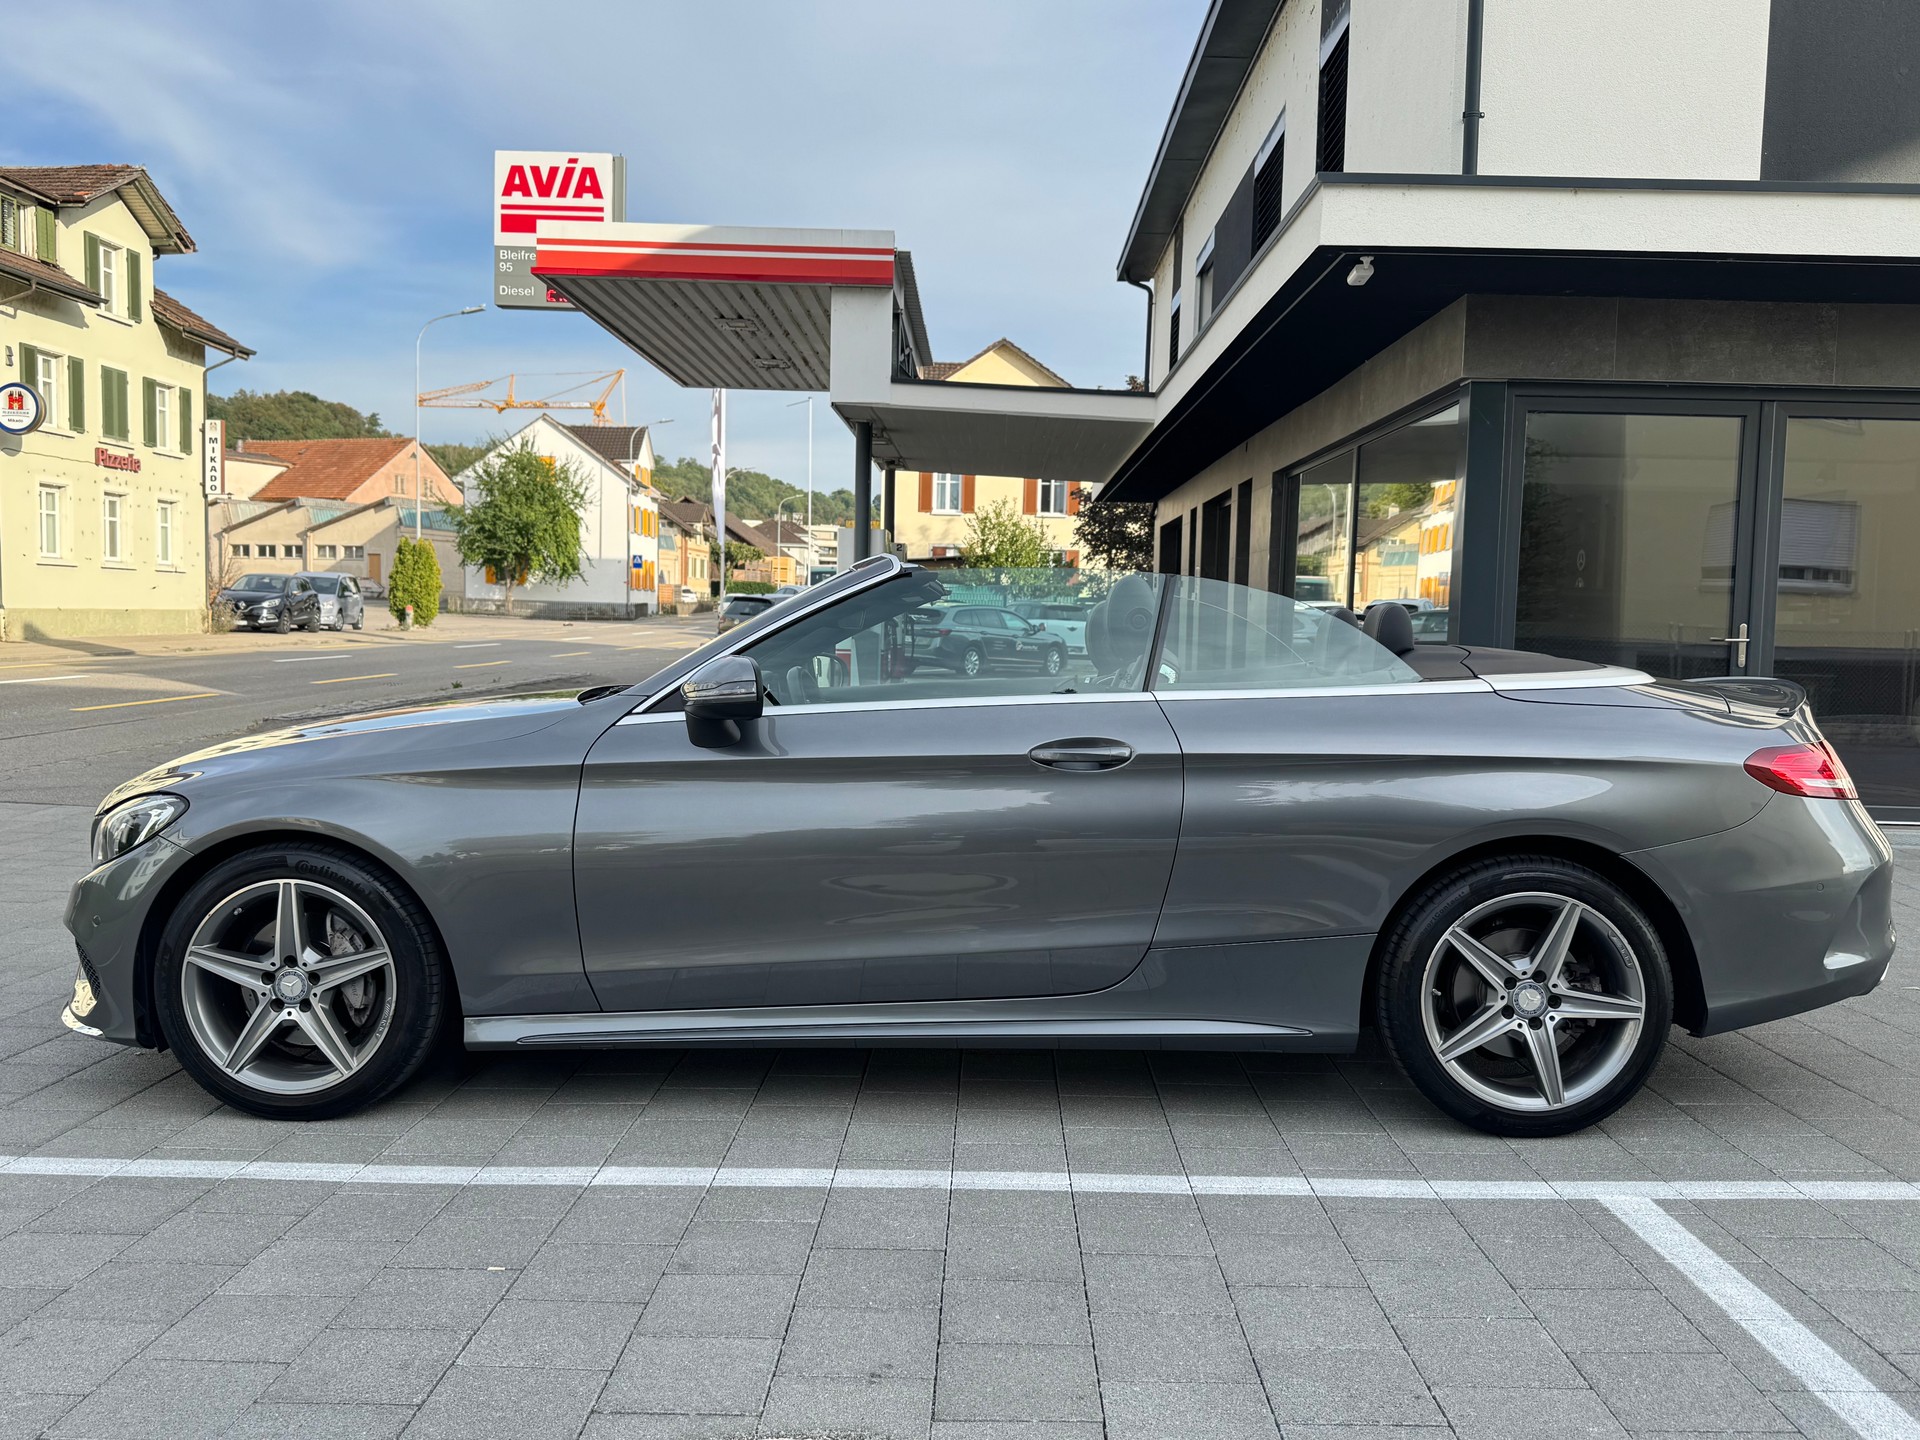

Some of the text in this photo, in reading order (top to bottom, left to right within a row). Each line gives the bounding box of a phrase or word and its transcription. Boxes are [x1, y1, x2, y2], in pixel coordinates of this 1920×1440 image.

[499, 249, 536, 261] Bleifre
[499, 262, 513, 272] 95
[499, 285, 535, 296] Diesel
[96, 448, 141, 472] Pizzeria
[208, 437, 219, 492] MIKADO
[896, 543, 903, 551] 2
